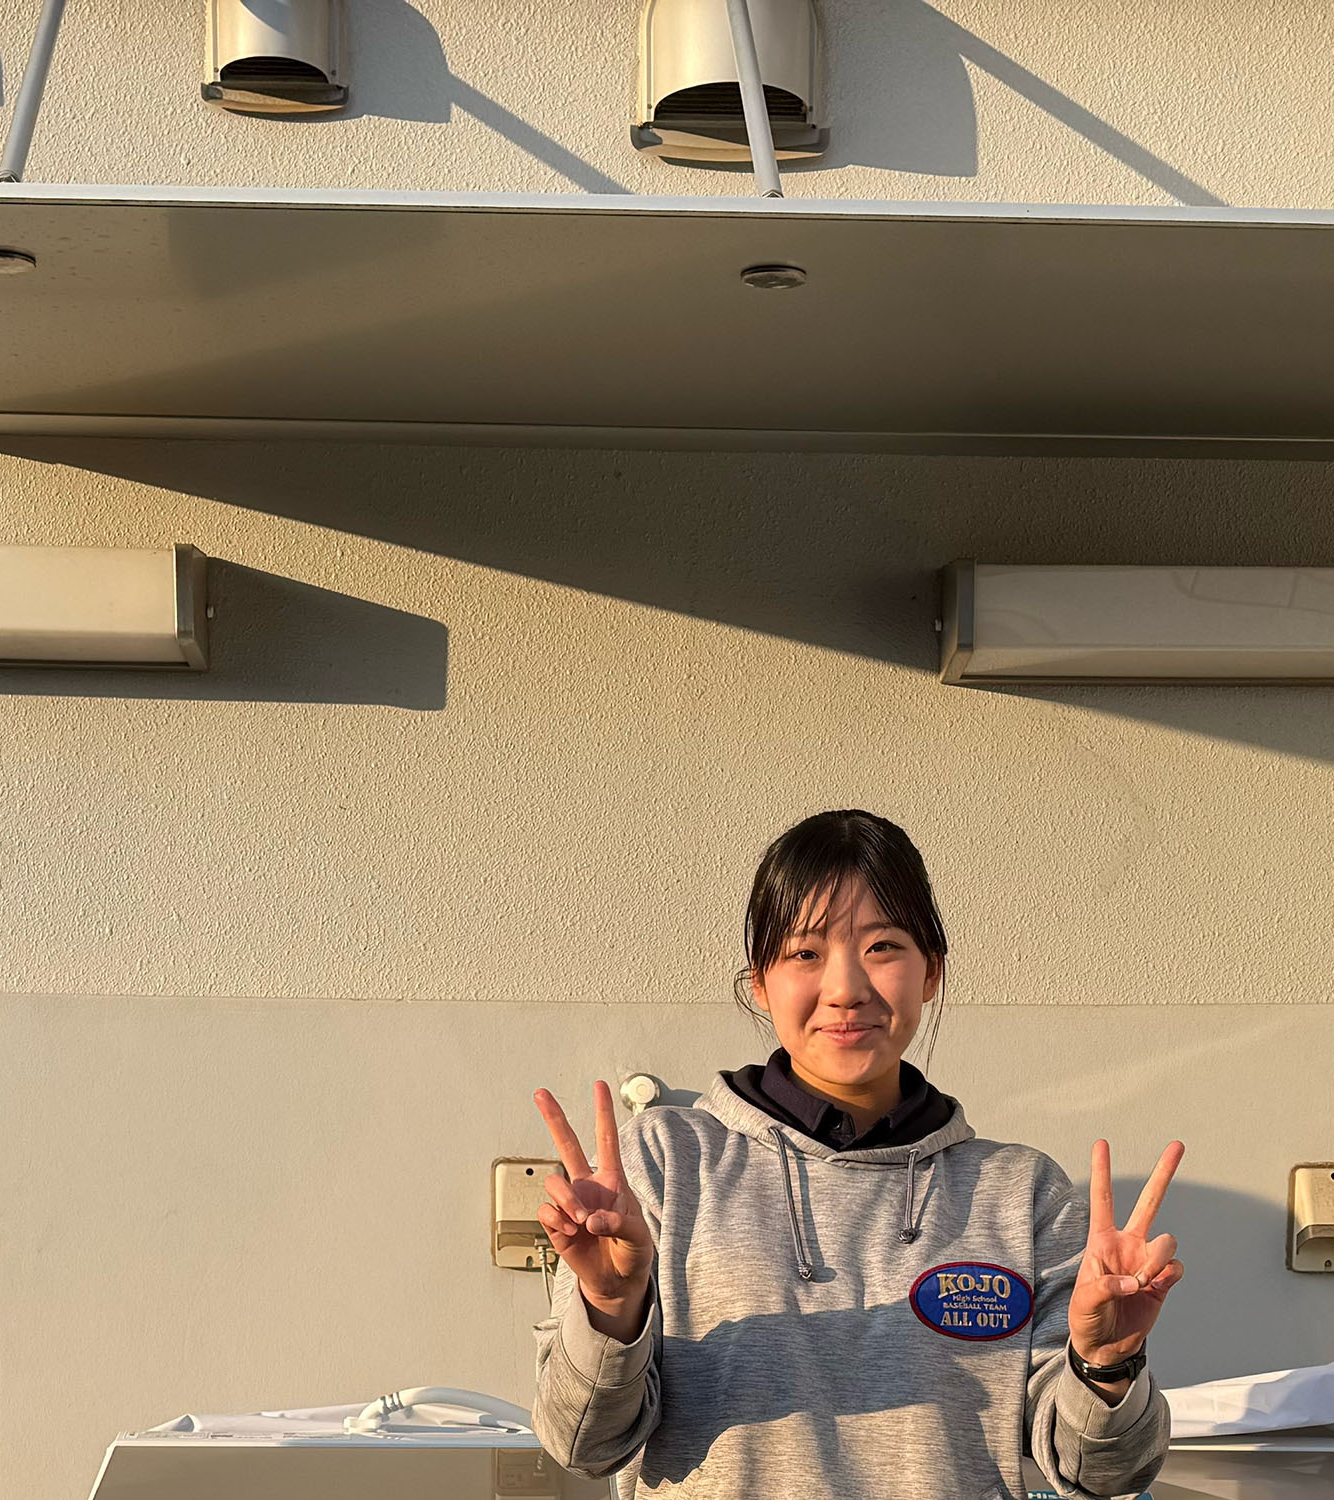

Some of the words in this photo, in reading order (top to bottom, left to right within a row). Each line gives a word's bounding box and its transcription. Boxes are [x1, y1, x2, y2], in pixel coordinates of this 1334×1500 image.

[937, 1273, 1011, 1299] KOJO
[984, 1303, 1007, 1311] TEAM
[940, 1311, 972, 1326] ALL
[976, 1312, 1011, 1328] OUT
